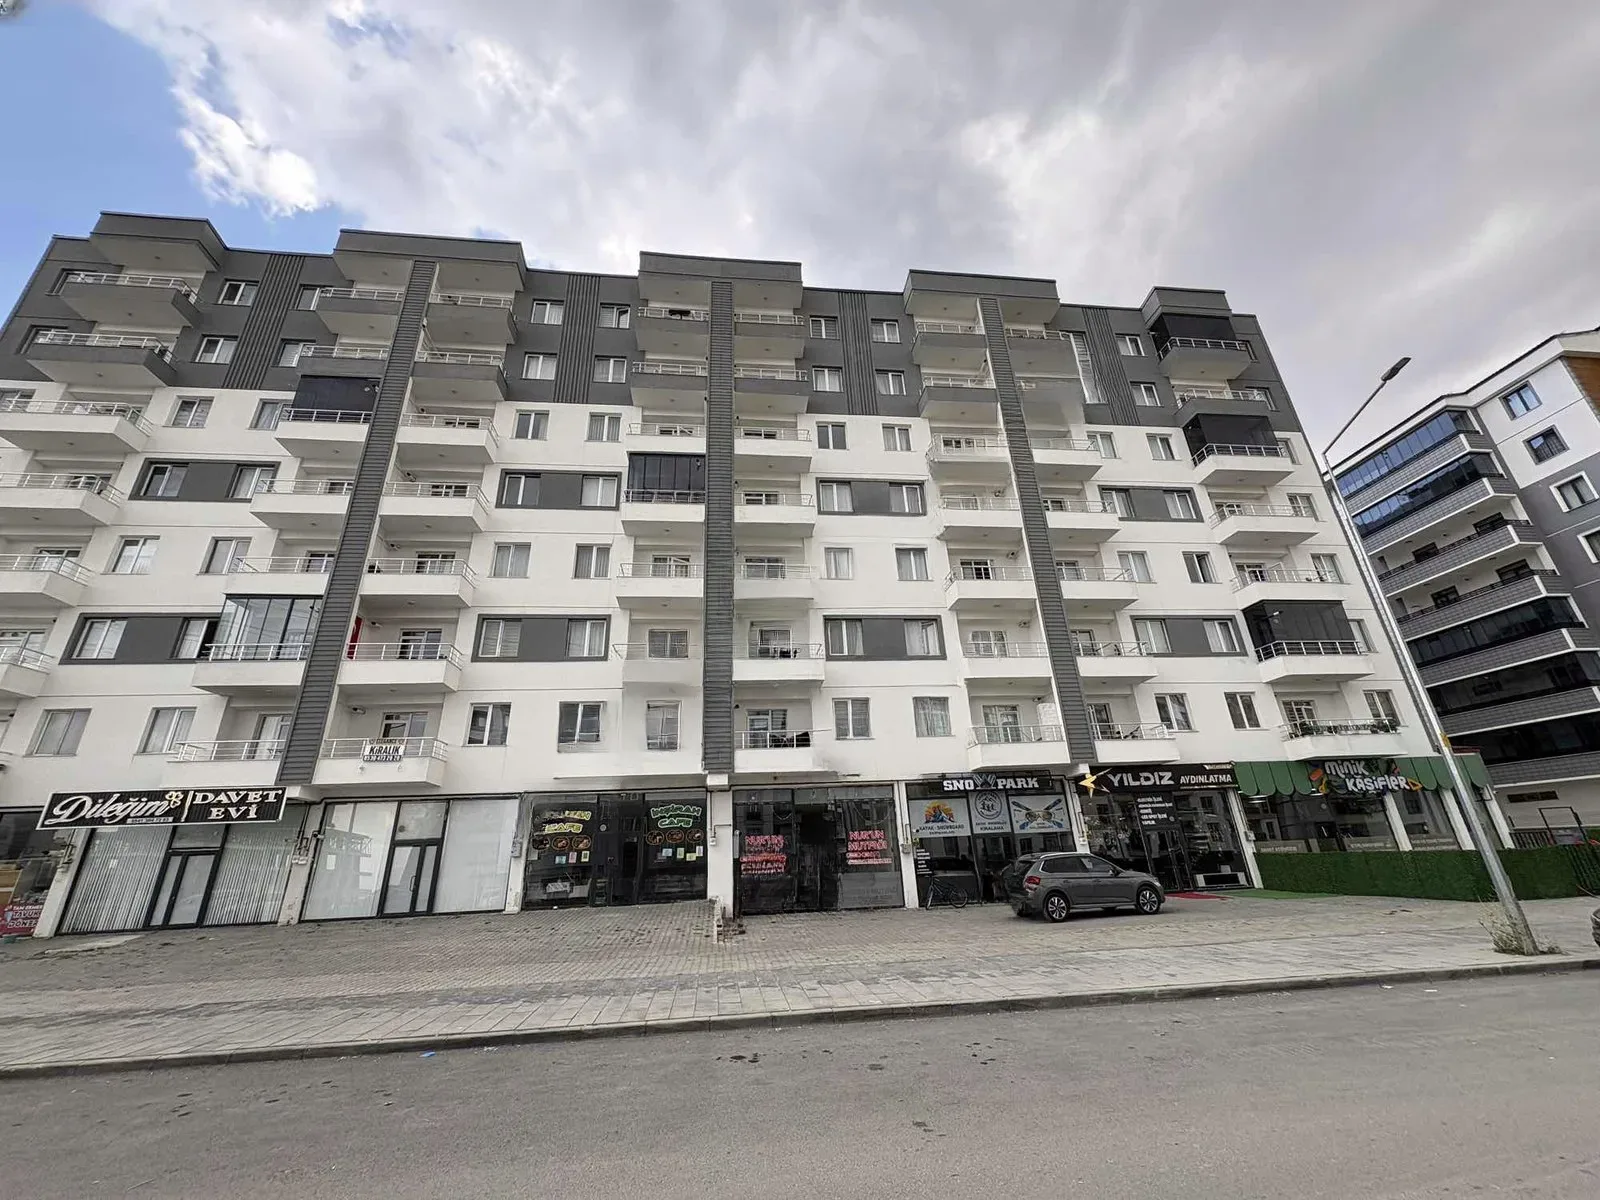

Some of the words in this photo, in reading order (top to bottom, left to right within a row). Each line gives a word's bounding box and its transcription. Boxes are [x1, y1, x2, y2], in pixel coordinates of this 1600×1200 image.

[1107, 772, 1174, 787] YILDIZ
[1180, 774, 1232, 784] AYDINLATMA
[193, 790, 282, 804] DAVET
[44, 794, 170, 825] Dileğim
[208, 804, 257, 820] EVİ
